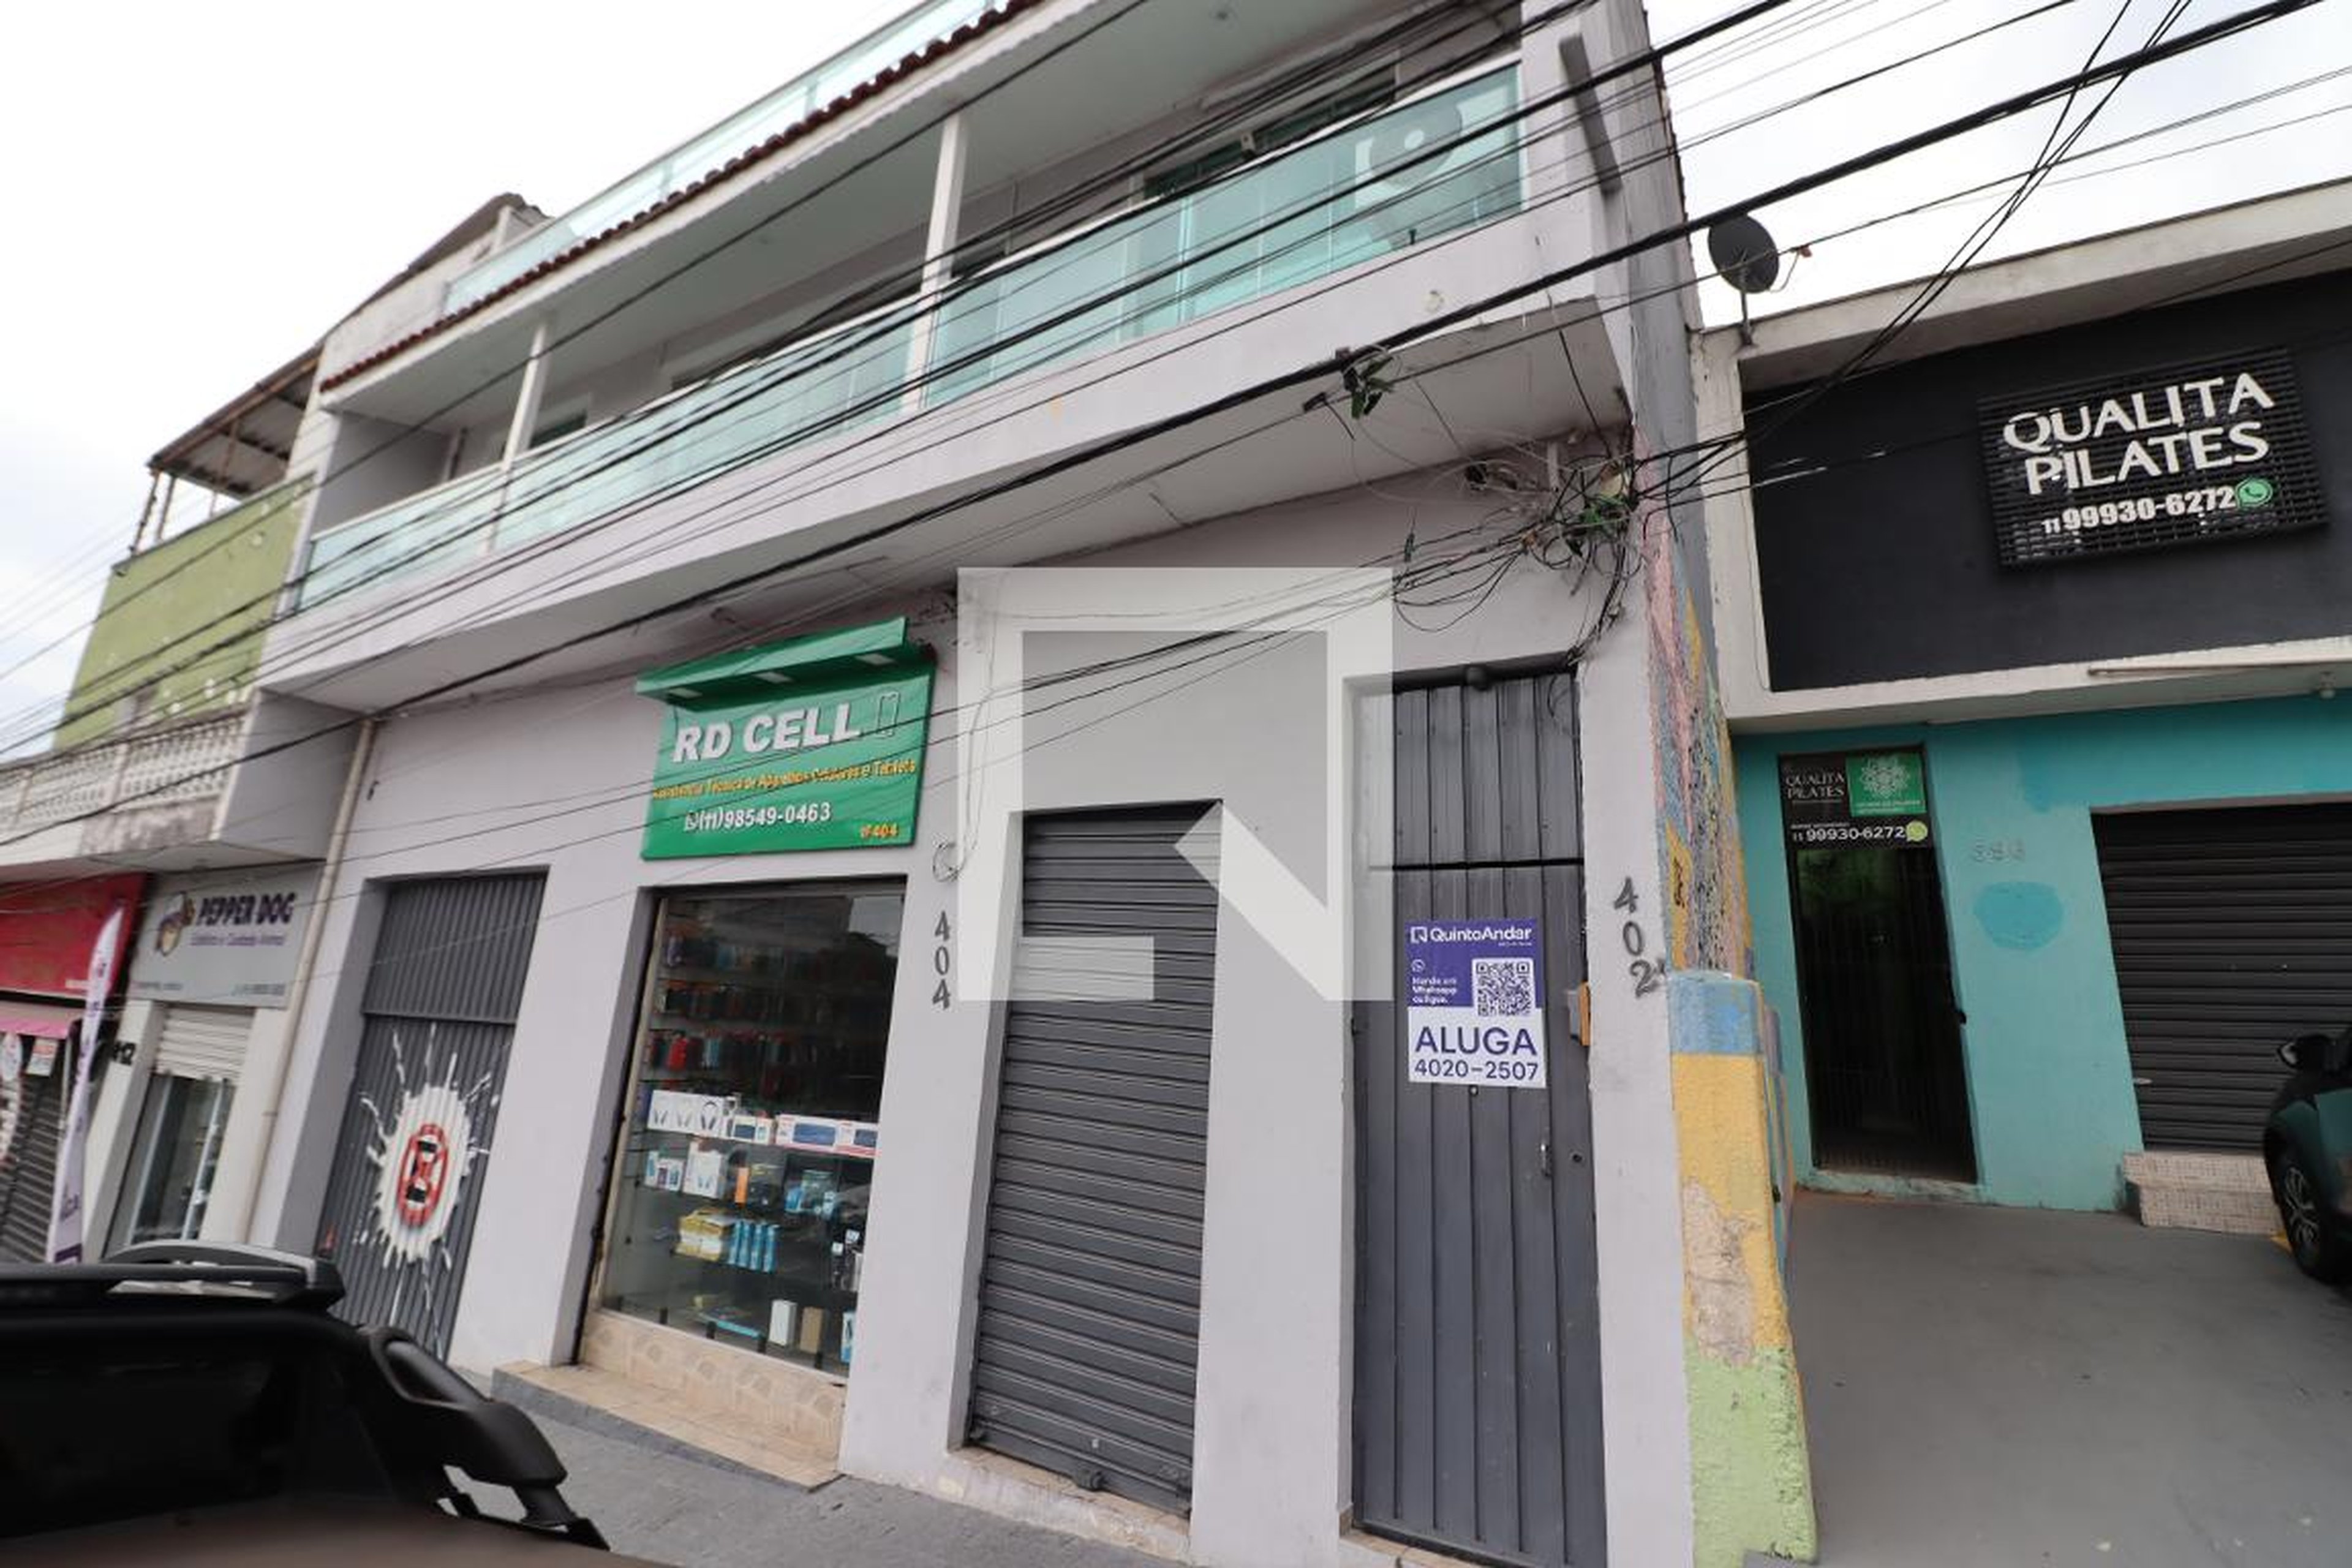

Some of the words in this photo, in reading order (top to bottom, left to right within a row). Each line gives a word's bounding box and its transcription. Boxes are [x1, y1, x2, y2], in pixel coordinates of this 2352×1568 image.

[2003, 372, 2275, 453] QUALITA
[2024, 421, 2269, 495] PILATES
[2062, 486, 2236, 530] 99930-6272
[673, 722, 732, 763] RD
[743, 703, 861, 753] CELL
[1787, 785, 1845, 799] PILATES
[1806, 826, 1905, 842] 99930-6272
[256, 892, 296, 925] DOG
[1430, 925, 1532, 942] QuintoAndar
[932, 910, 951, 1011] 404
[1415, 1026, 1538, 1056] ALUGA
[1415, 1059, 1539, 1080] 4020-2507
